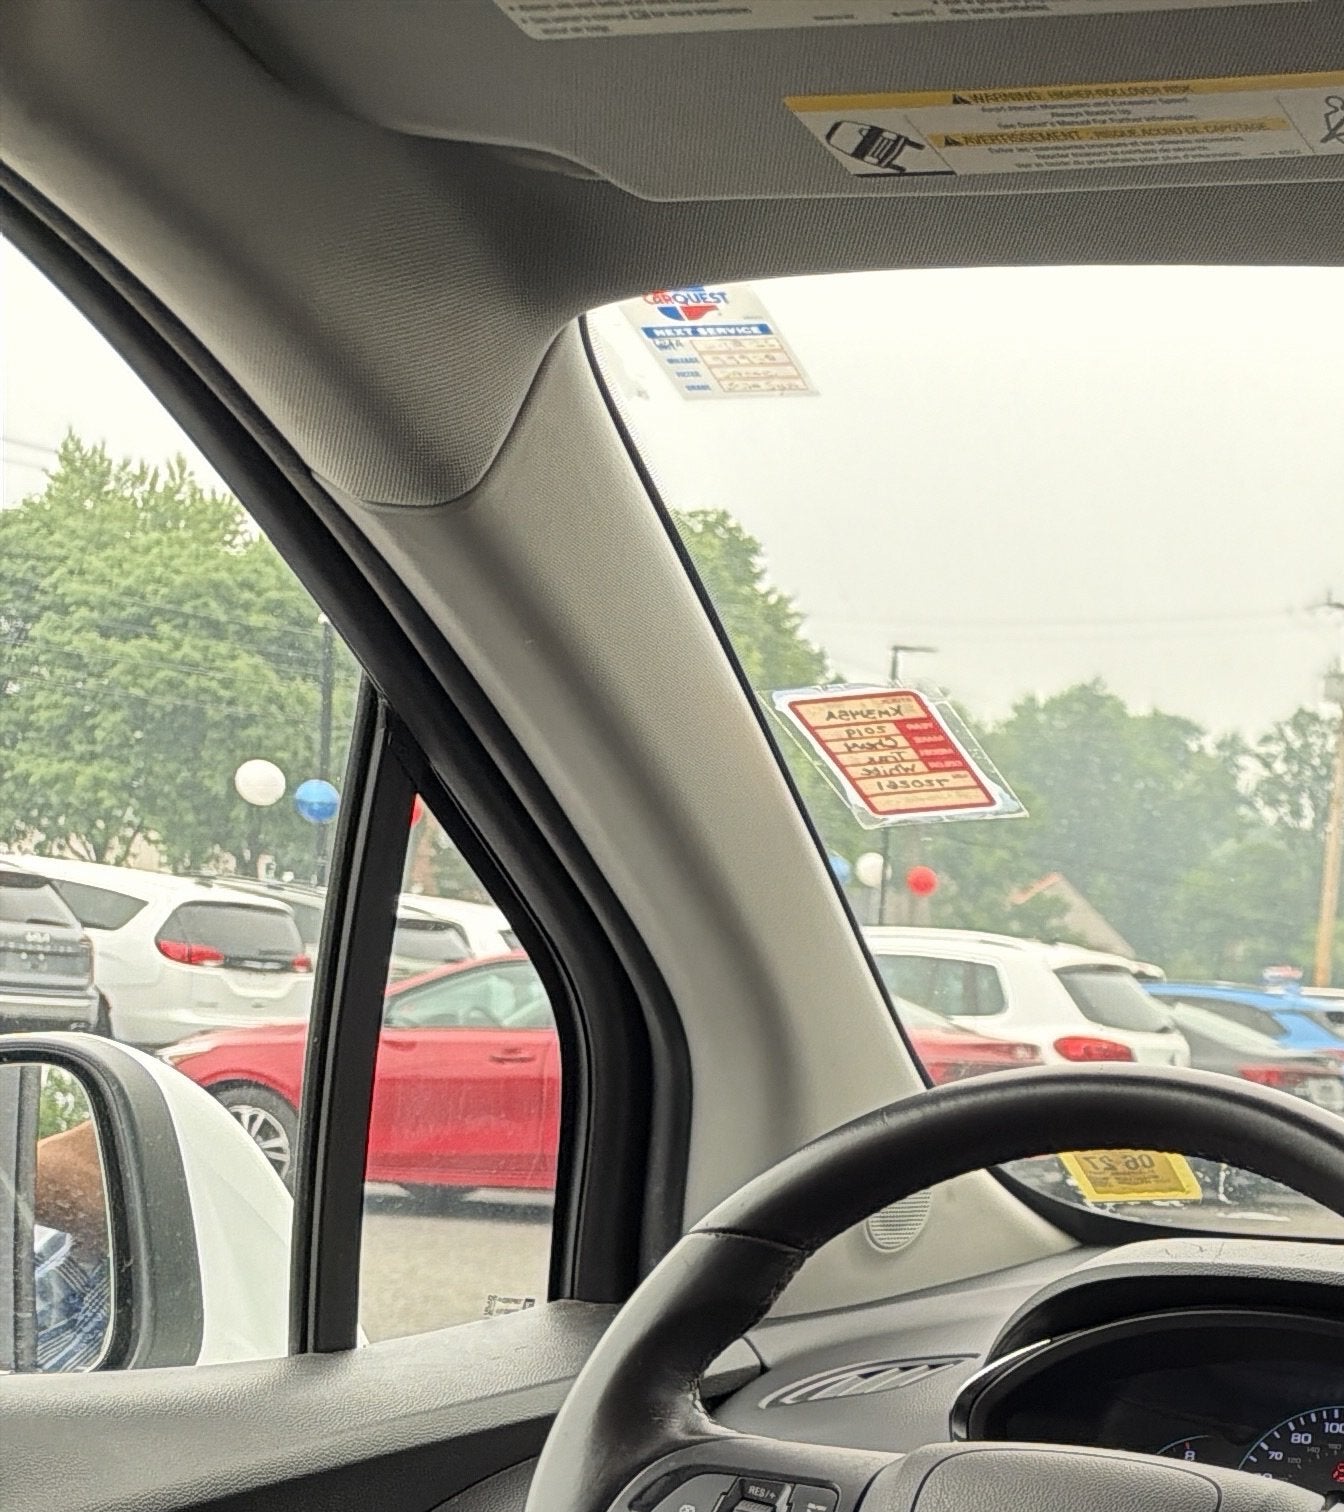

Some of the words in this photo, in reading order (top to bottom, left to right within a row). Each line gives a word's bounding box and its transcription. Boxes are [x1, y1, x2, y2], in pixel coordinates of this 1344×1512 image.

[655, 327, 693, 338] NEXT
[696, 325, 763, 336] SERVICE
[1290, 1432, 1312, 1445] 80
[1184, 1449, 1195, 1462] 8
[1268, 1451, 1284, 1461] 70
